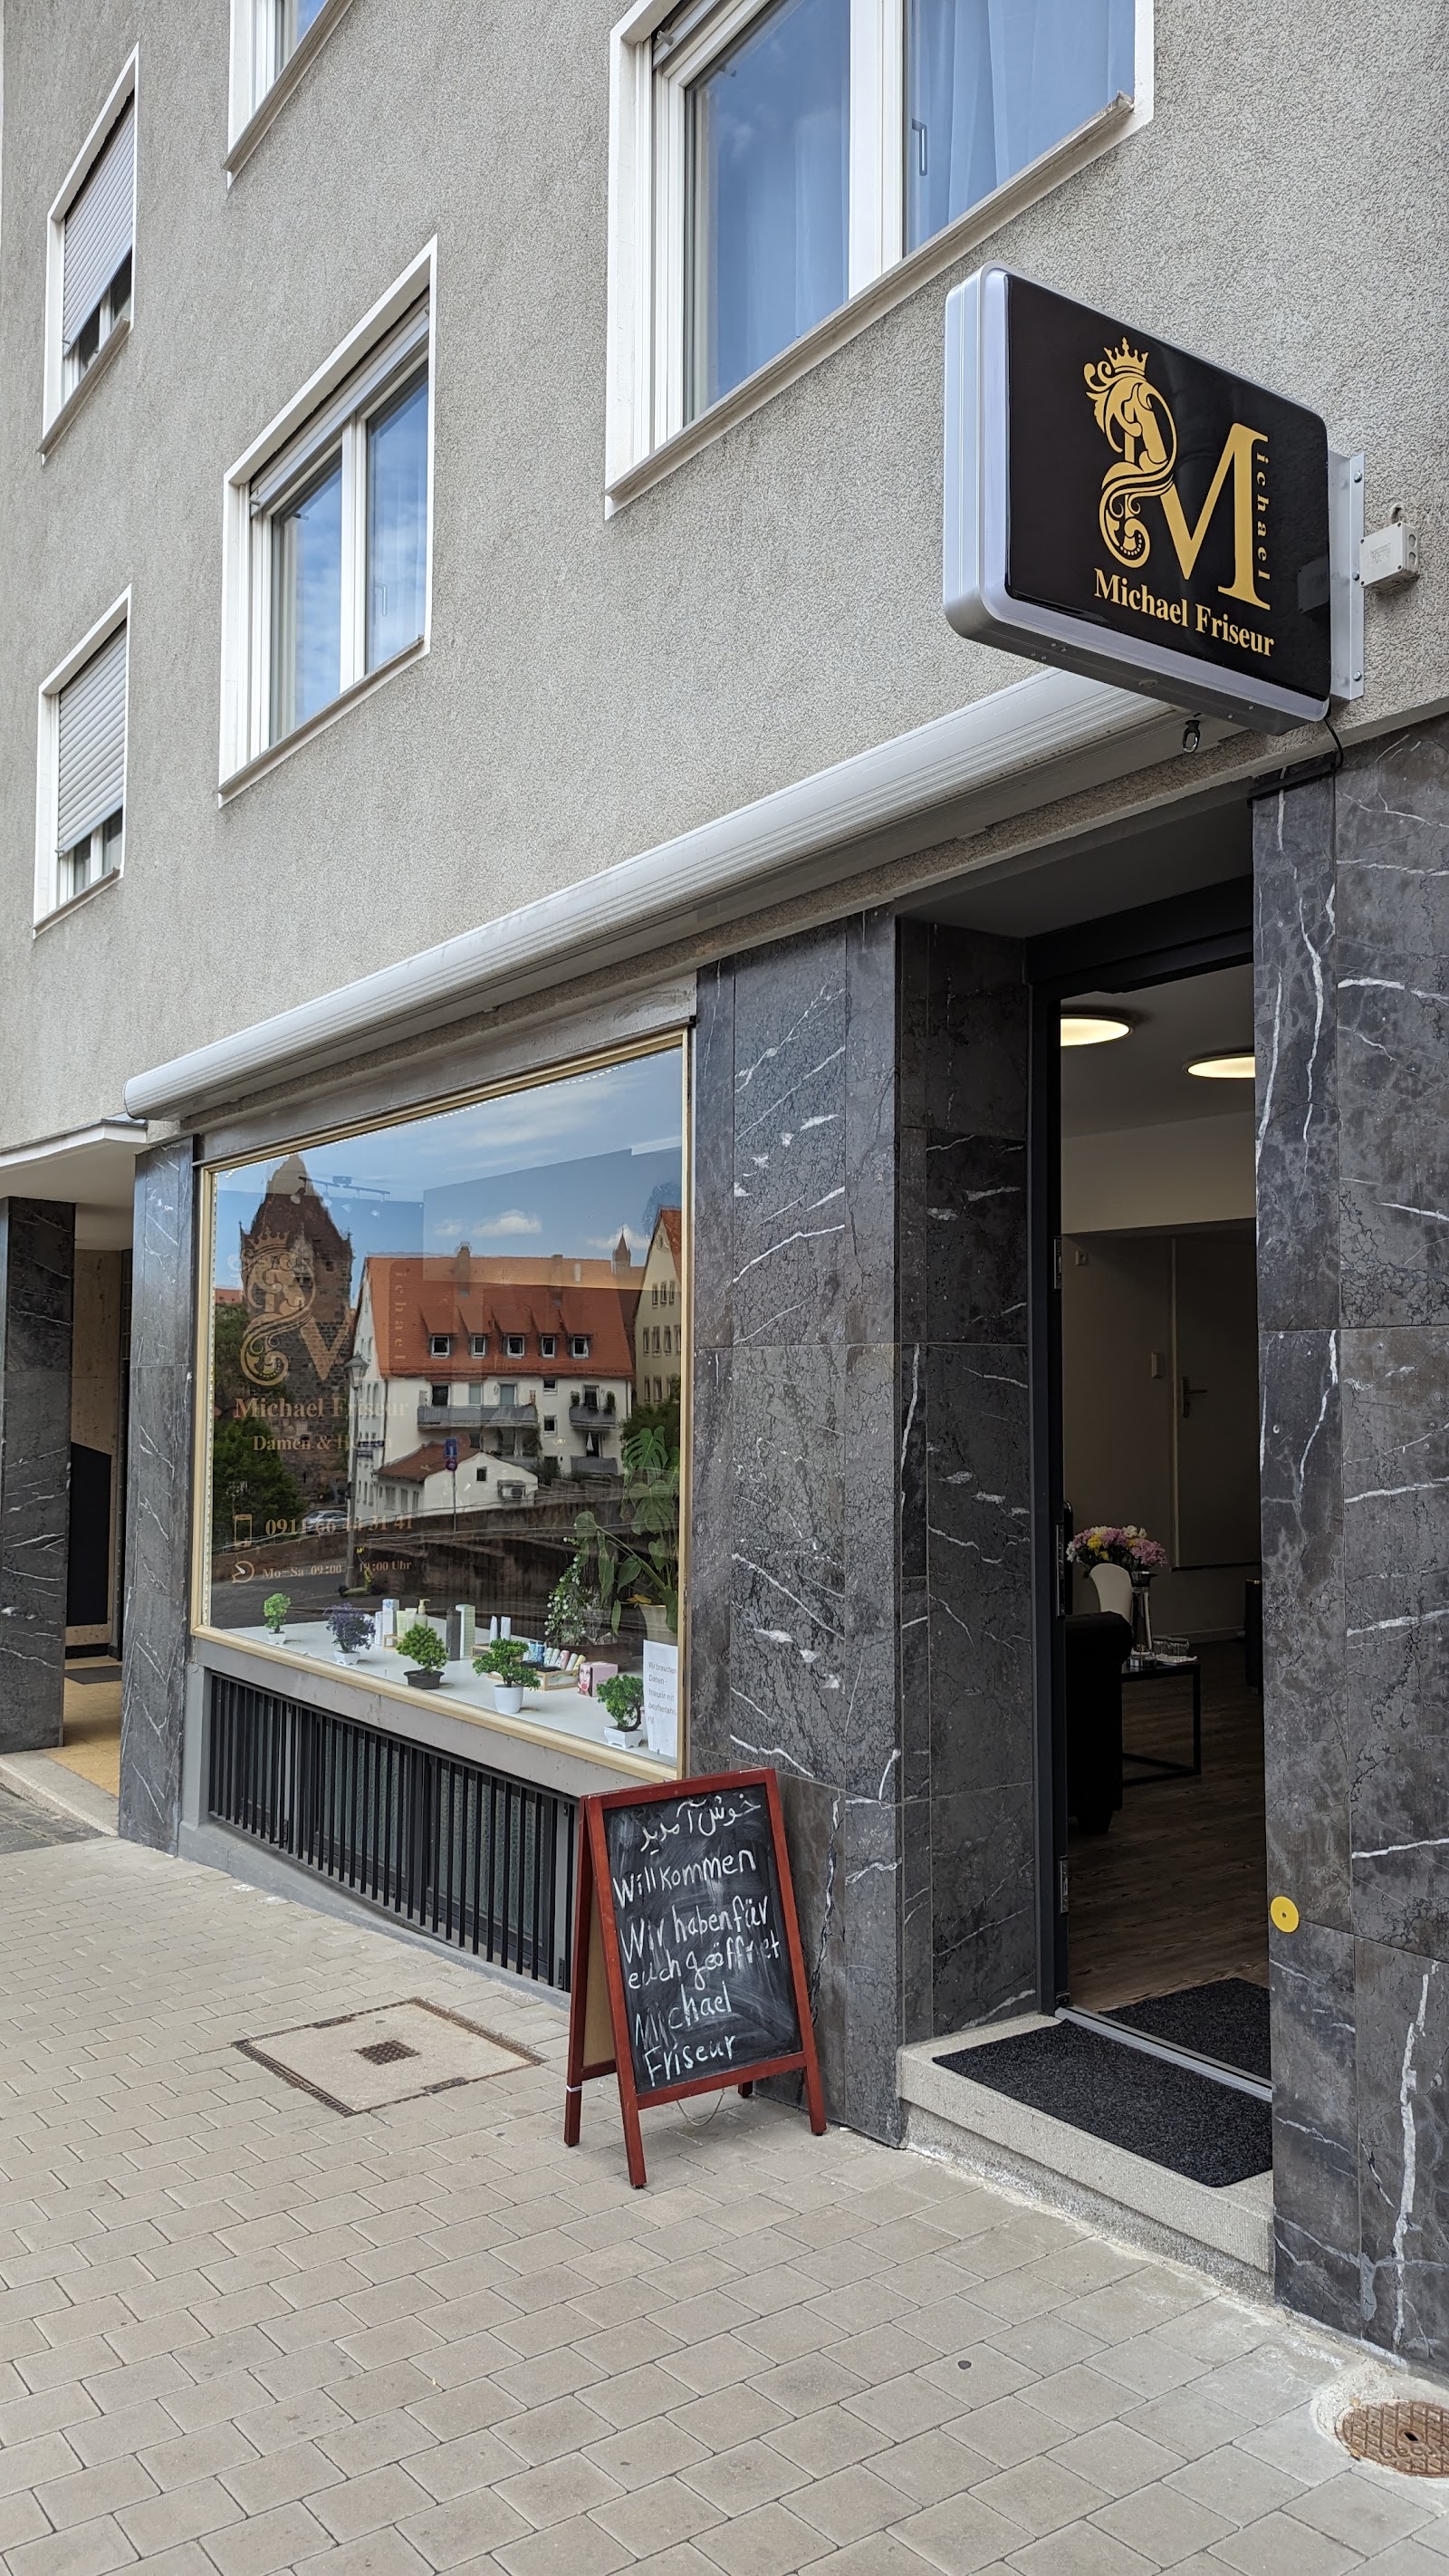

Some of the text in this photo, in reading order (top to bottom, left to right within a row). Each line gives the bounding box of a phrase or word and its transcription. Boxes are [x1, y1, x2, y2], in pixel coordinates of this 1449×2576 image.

[1093, 567, 1274, 657] Michael Friseur
[234, 1398, 324, 1418] Michael
[253, 1435, 311, 1451] Damen
[317, 1435, 332, 1450] &
[264, 1518, 307, 1537] 0911
[394, 1513, 414, 1530] 41
[391, 1561, 412, 1572] Uhr
[613, 1849, 756, 1909] Willkommen
[619, 1895, 768, 1964] Wir haben für
[629, 1949, 681, 1989] euch
[636, 1981, 736, 2087] Michael Friseur
